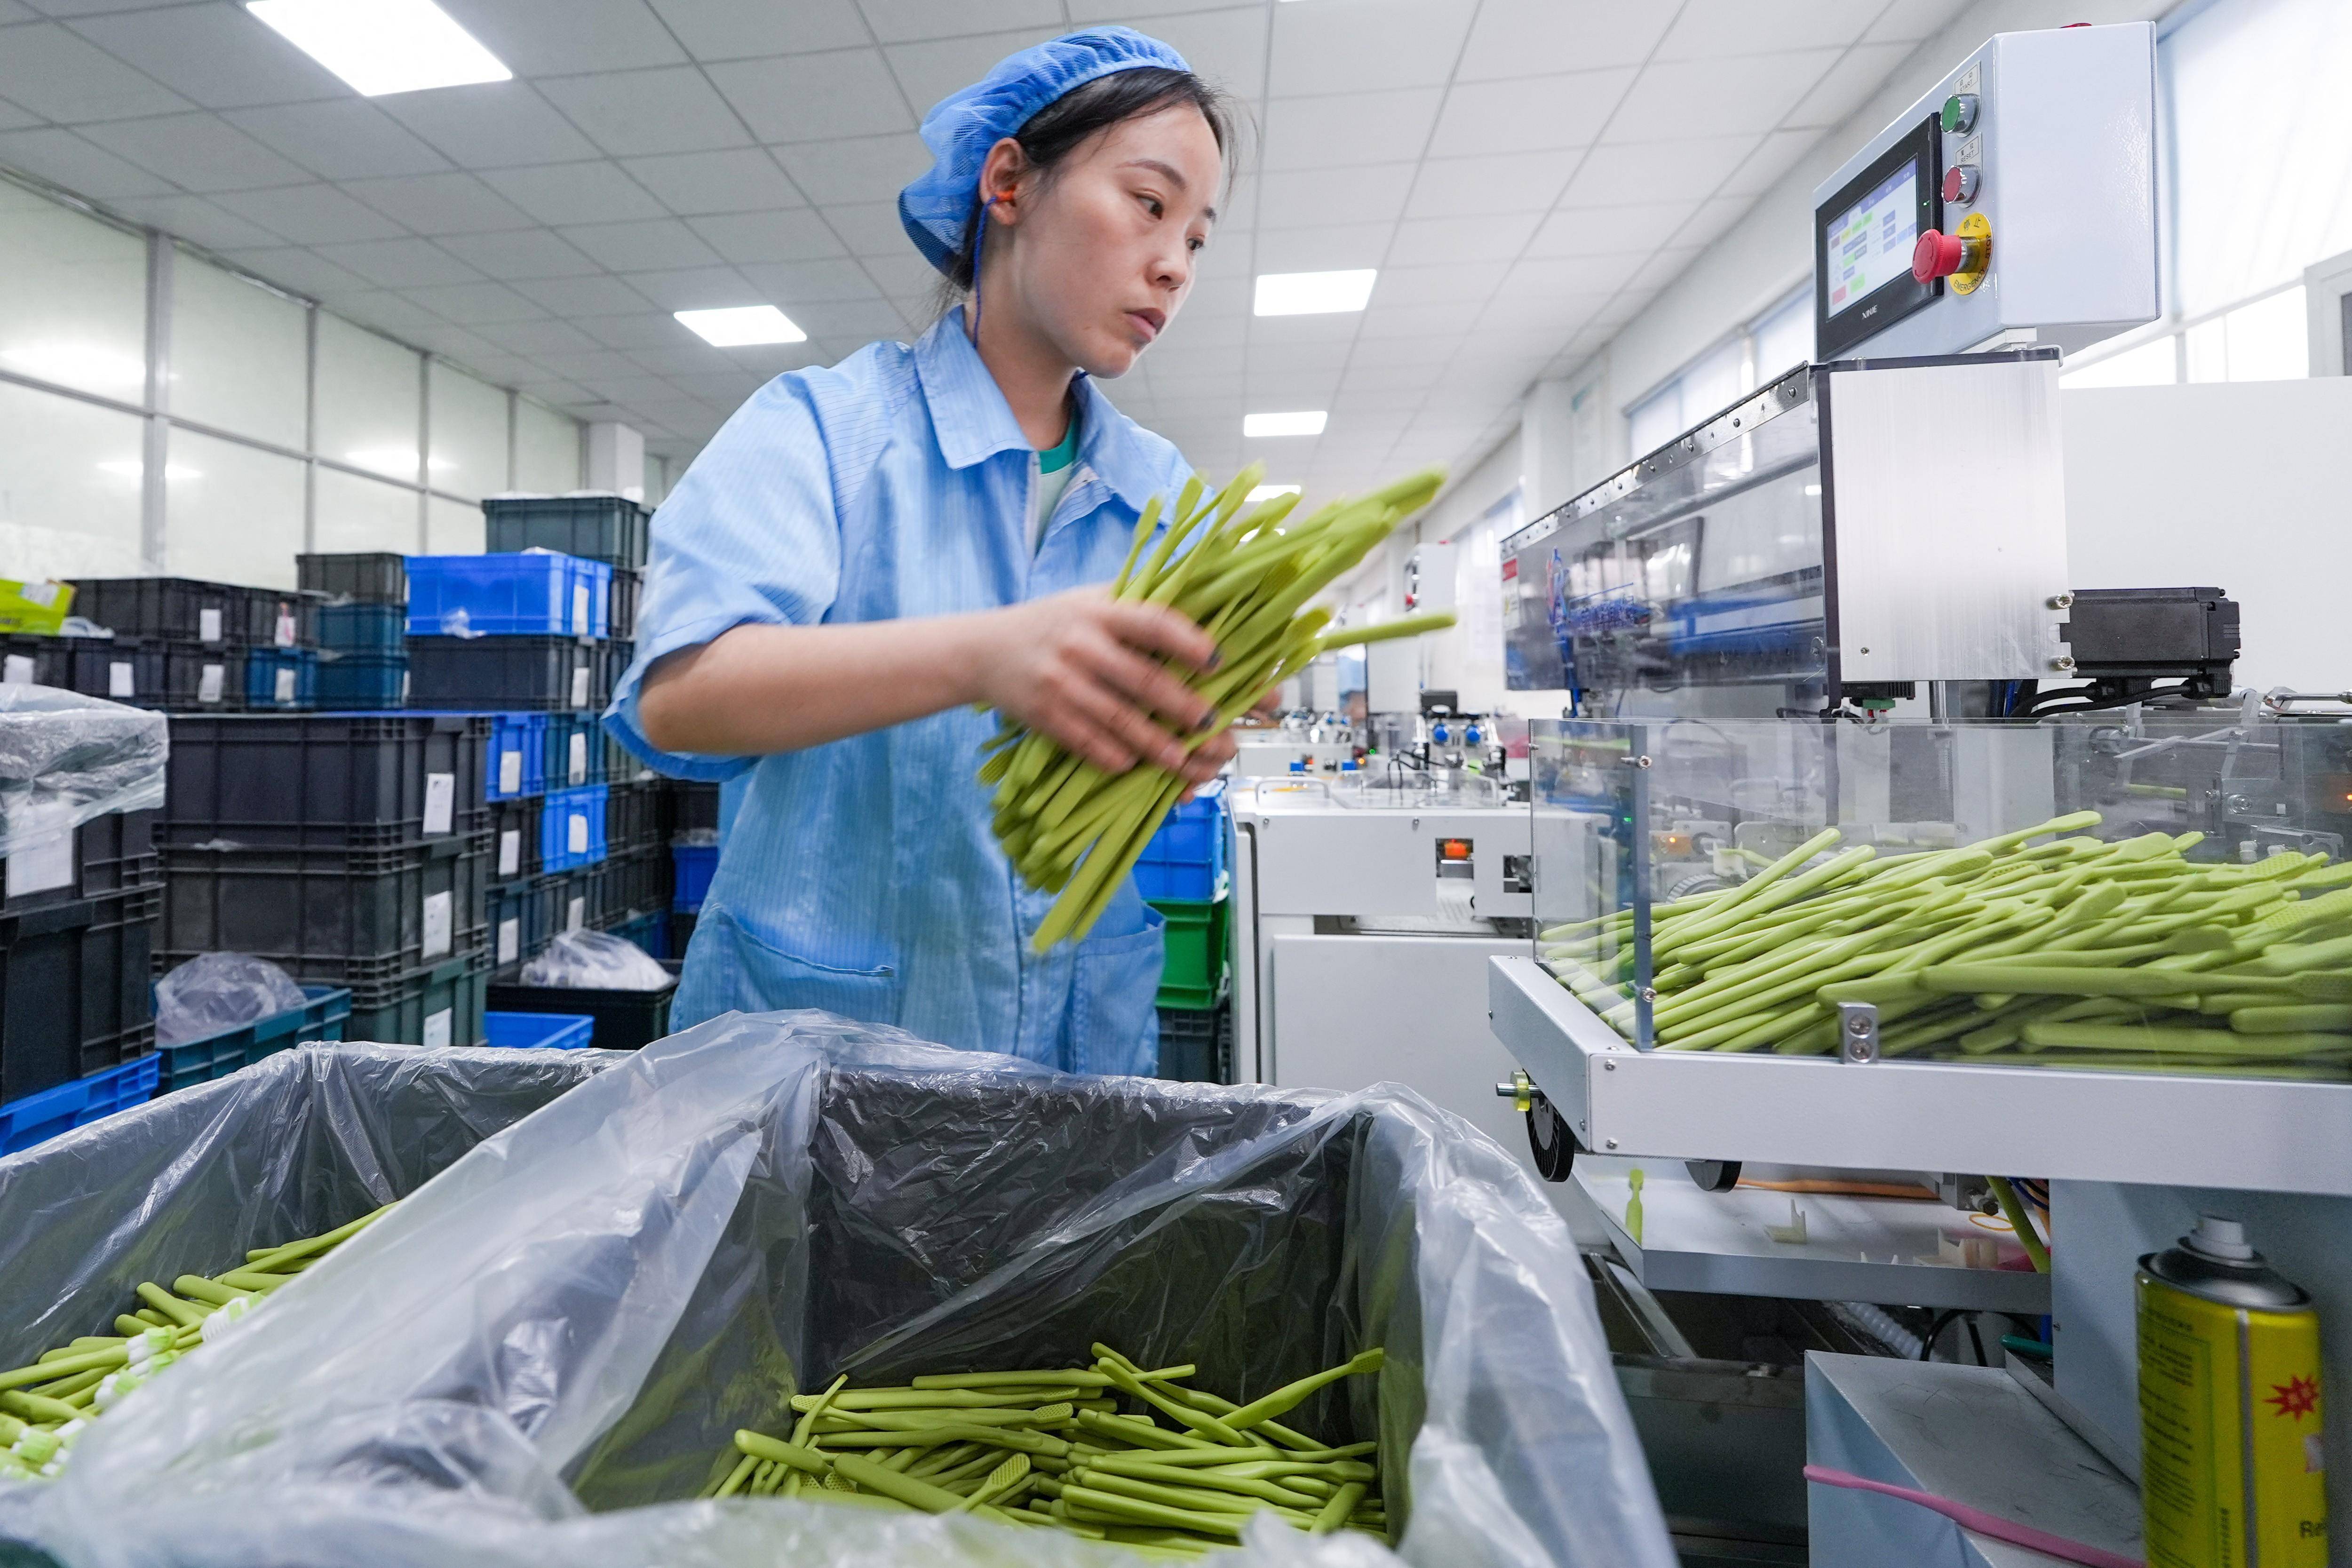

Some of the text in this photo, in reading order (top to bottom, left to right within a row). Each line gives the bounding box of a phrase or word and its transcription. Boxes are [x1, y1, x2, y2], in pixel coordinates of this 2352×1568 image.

[1960, 79, 1972, 93] START
[1961, 150, 1974, 164] RESET
[1954, 269, 1986, 292] EMERGENCY
